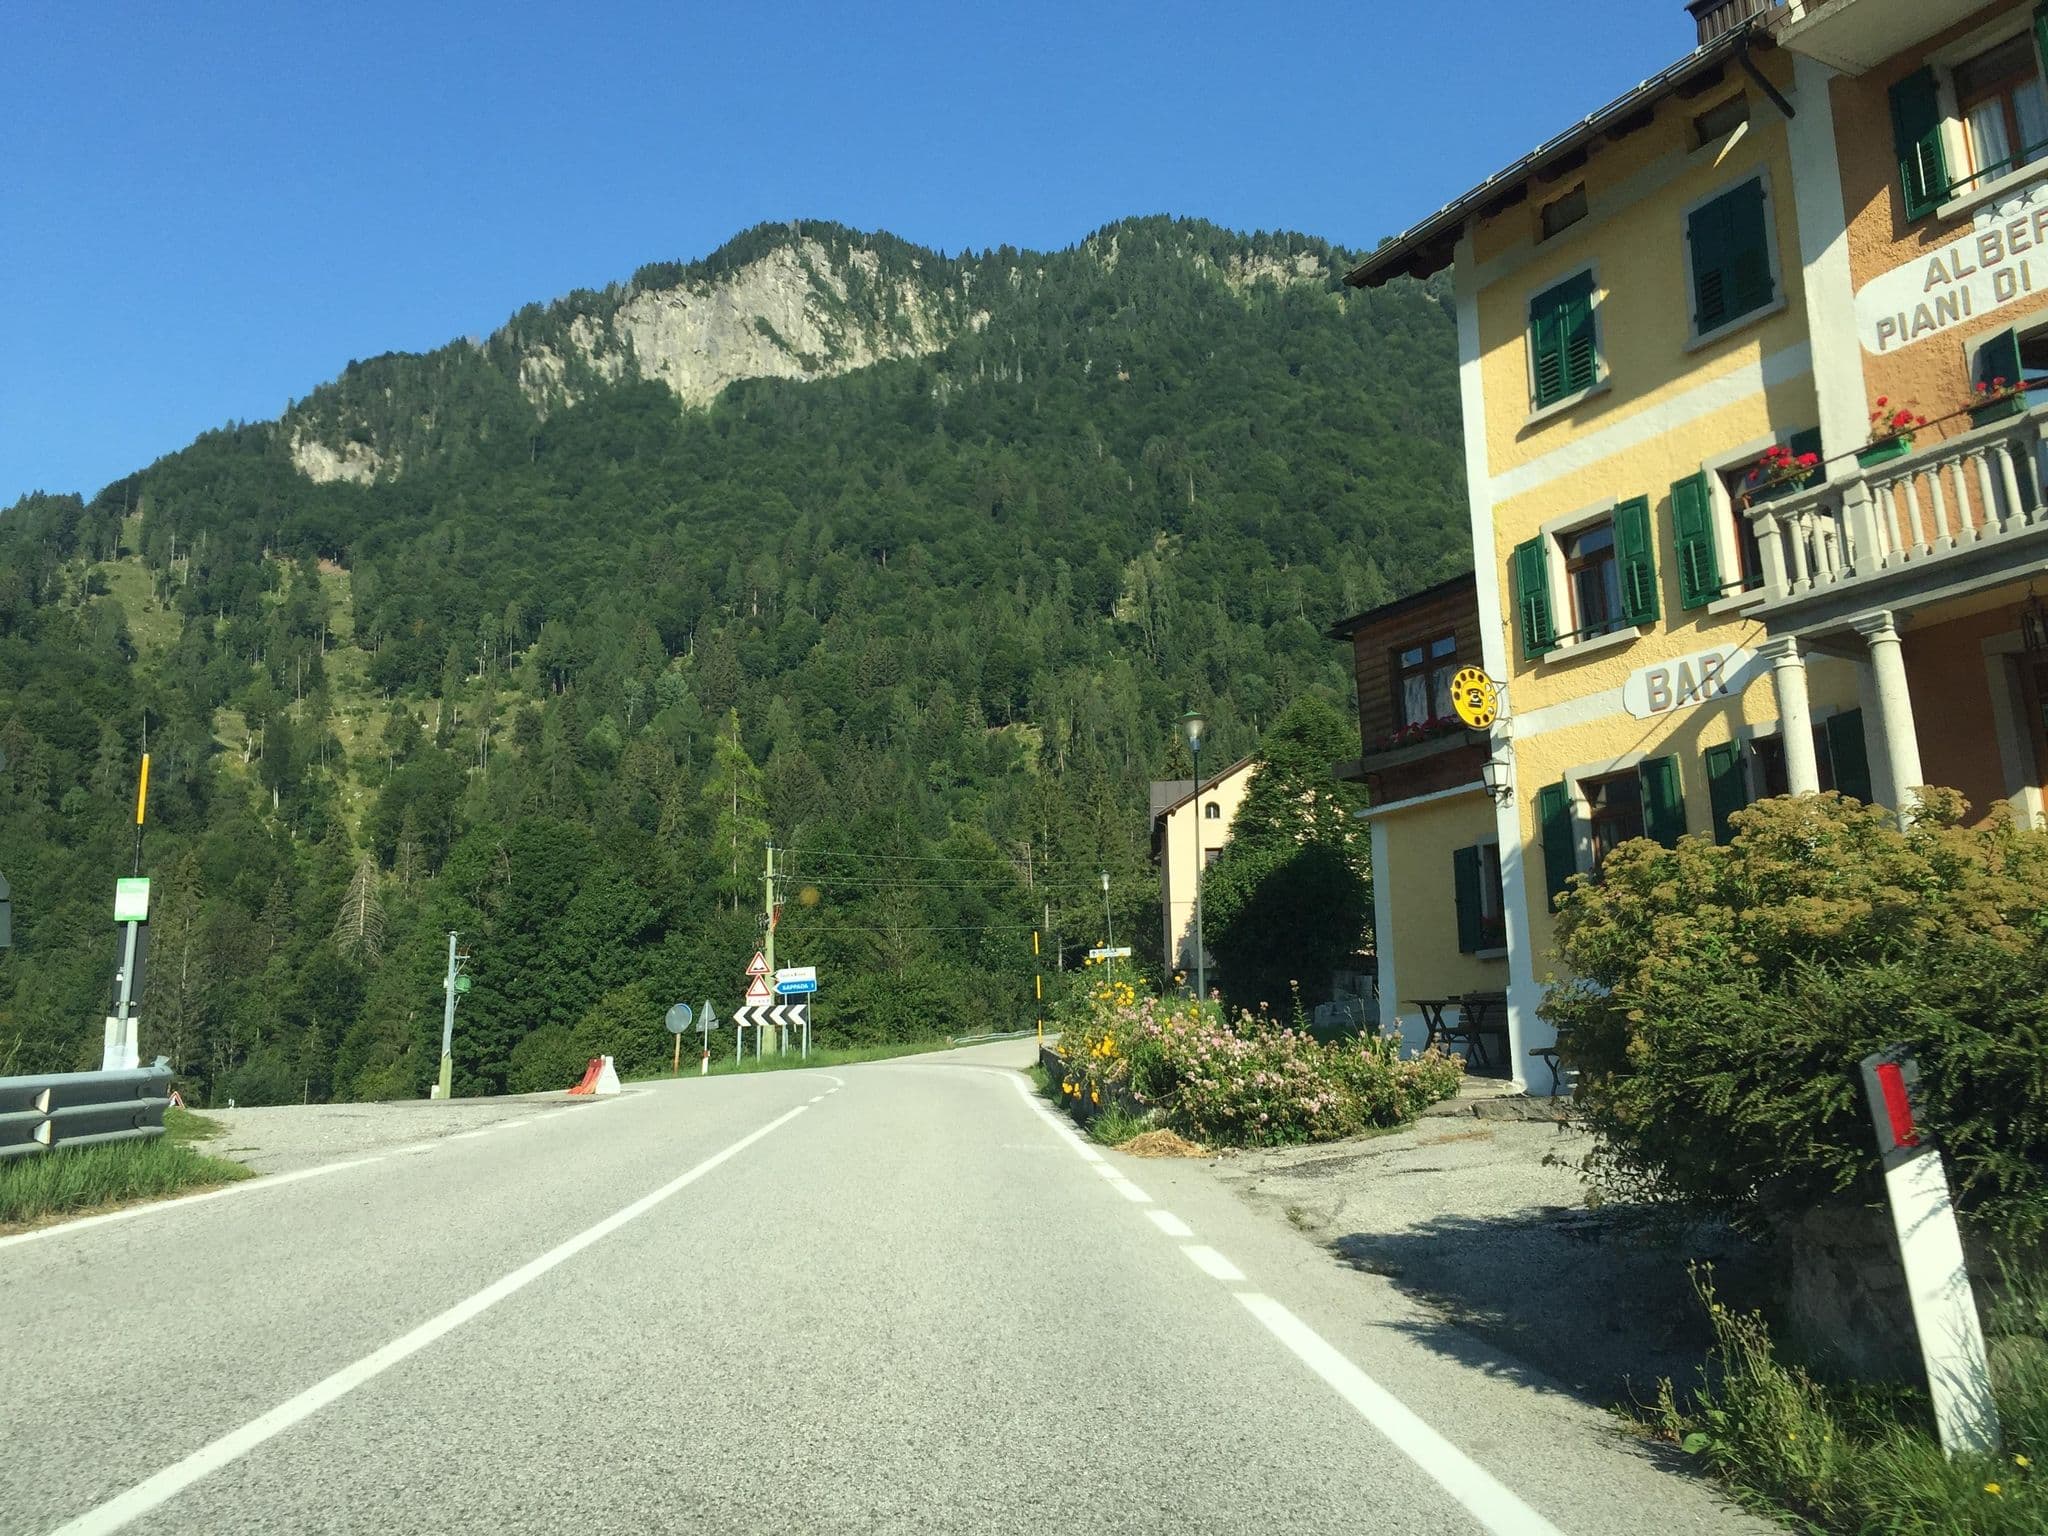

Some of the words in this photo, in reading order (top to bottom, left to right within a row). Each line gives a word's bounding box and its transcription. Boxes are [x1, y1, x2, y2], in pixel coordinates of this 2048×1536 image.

[1876, 285, 1972, 351] PIANI
[1992, 259, 2032, 303] DI
[1645, 652, 1728, 713] BAR
